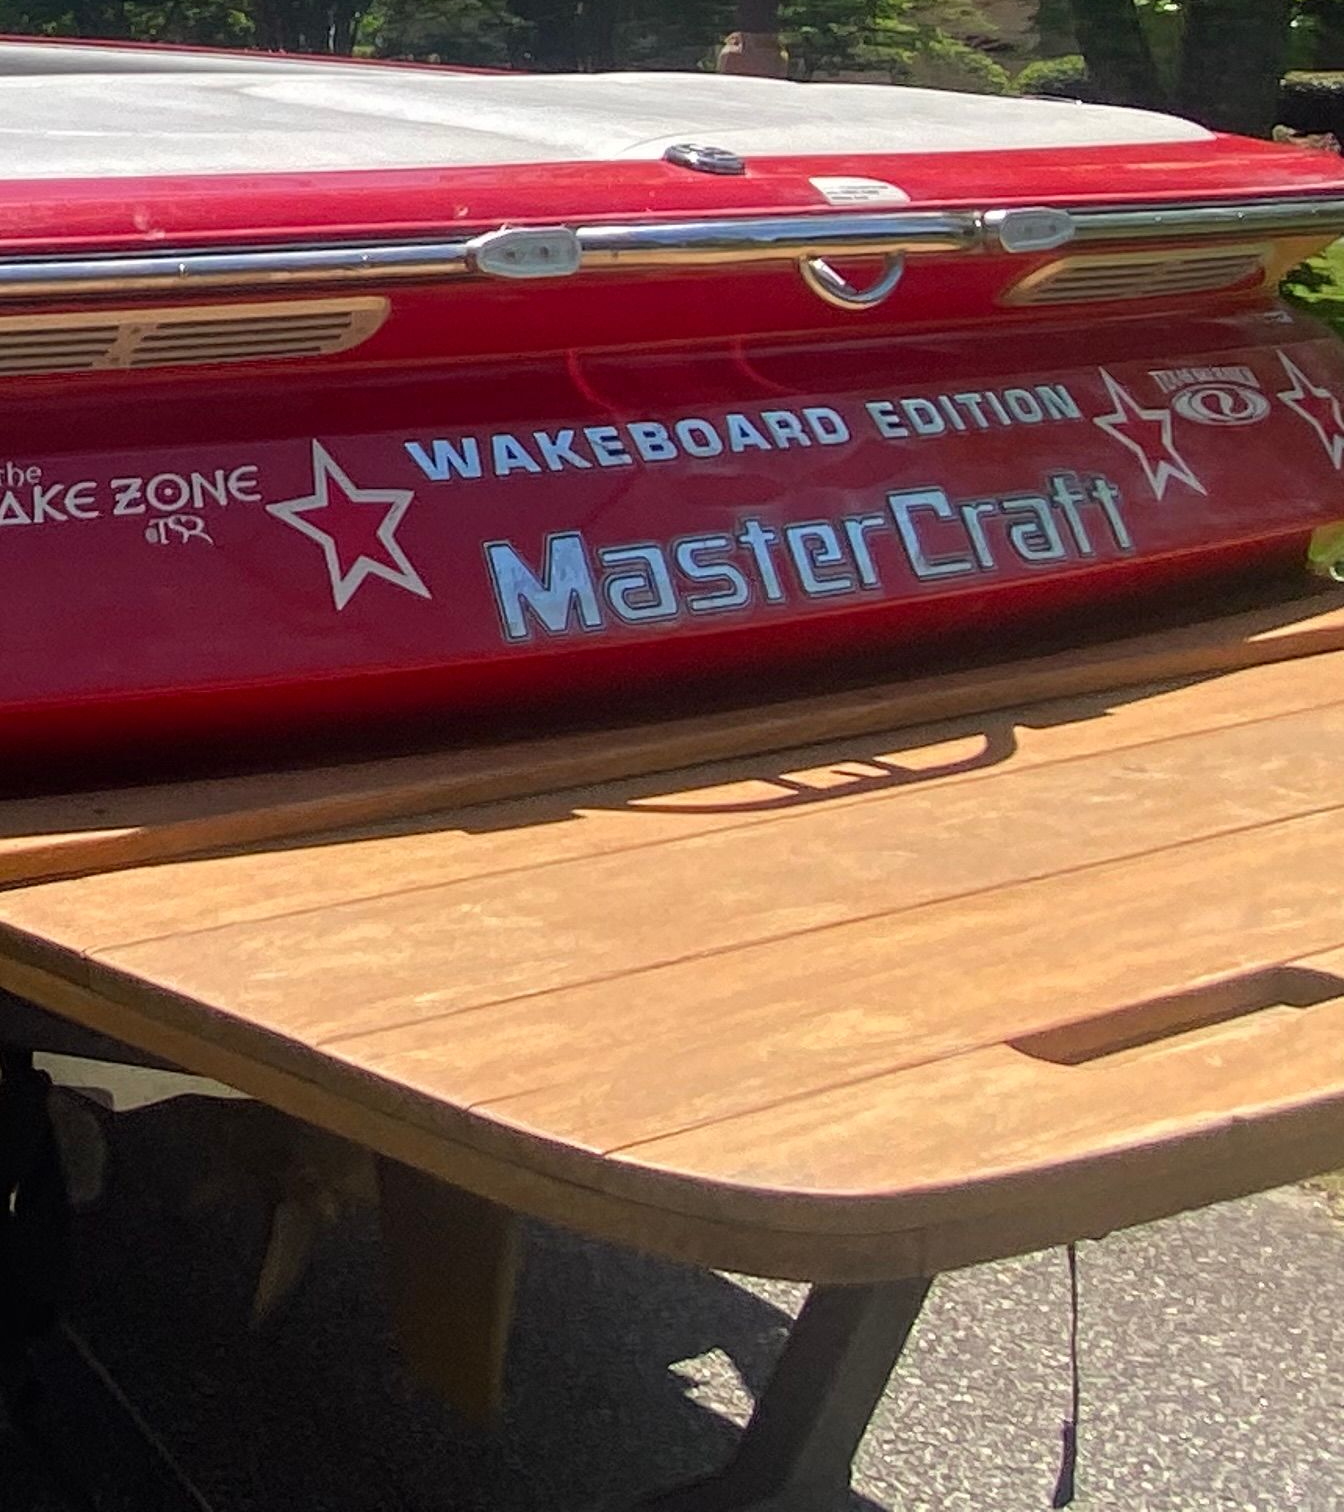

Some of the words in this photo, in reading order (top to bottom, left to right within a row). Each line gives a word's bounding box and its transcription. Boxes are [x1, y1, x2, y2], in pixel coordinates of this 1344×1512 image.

[404, 405, 853, 482] WAKEBOARD
[865, 384, 1084, 441] EDITION
[110, 465, 263, 516] ZONE
[482, 470, 1133, 645] MasterCraft
